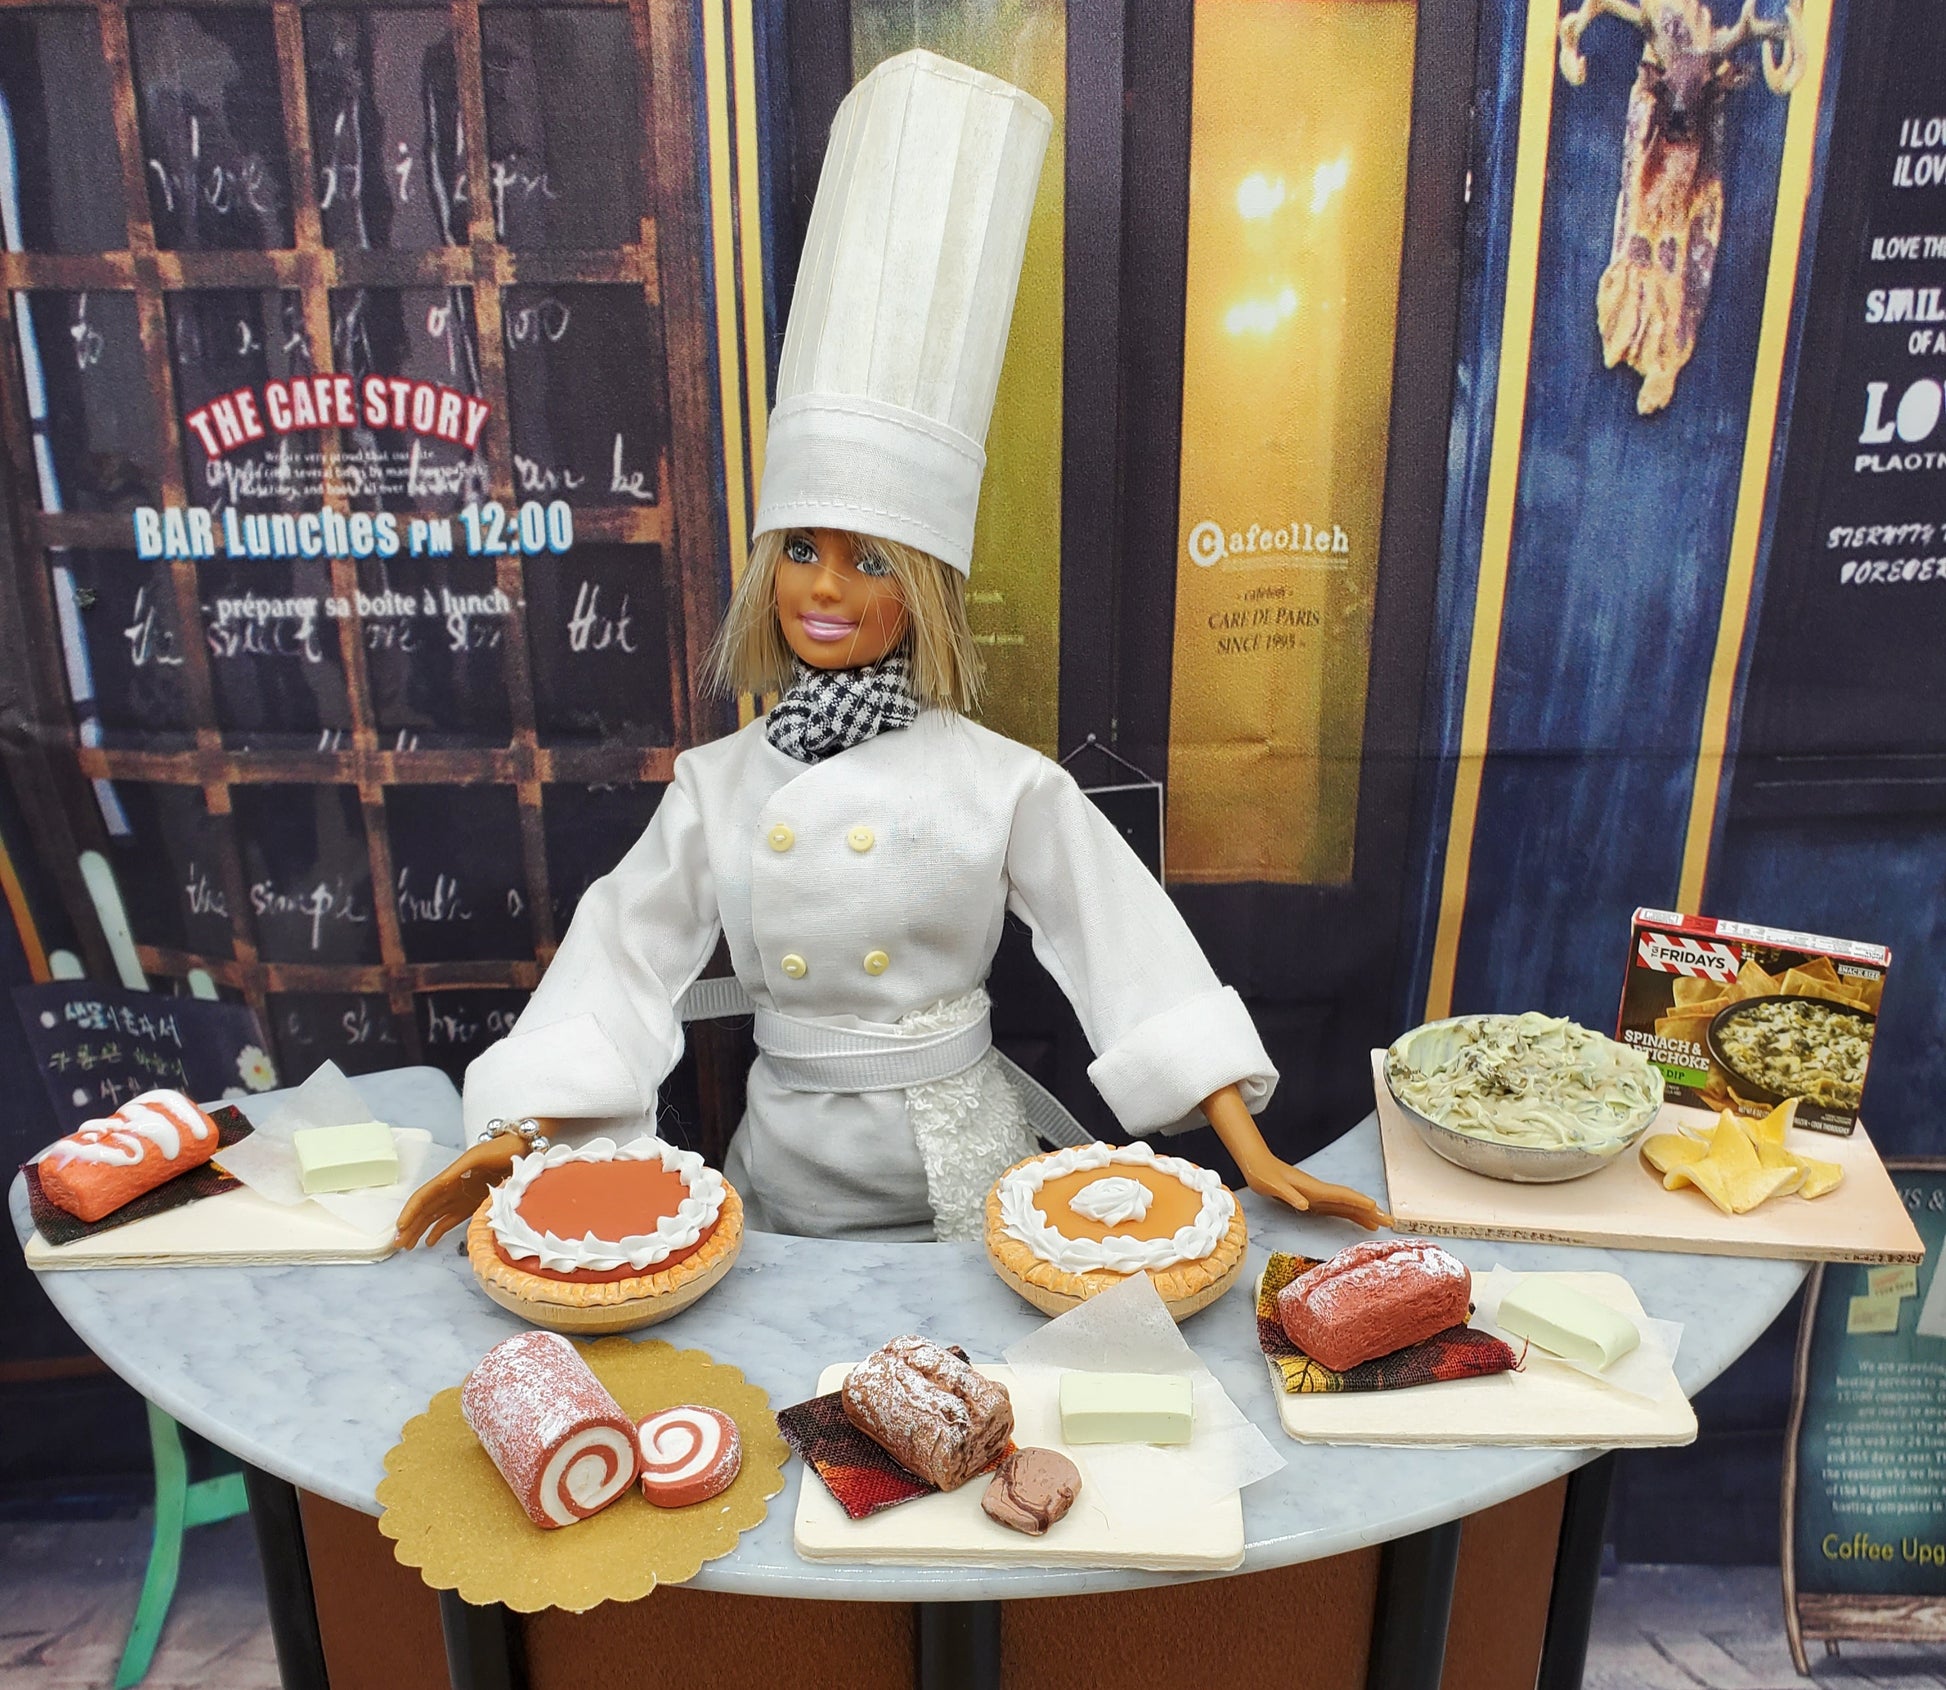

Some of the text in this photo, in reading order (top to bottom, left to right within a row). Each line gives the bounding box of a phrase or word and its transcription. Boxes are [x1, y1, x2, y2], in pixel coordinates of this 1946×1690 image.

[1892, 154, 1946, 187] ILOV
[1865, 288, 1946, 323] SMIL
[1908, 330, 1933, 355] OF
[188, 376, 489, 458] THE CAFE STORY
[1858, 379, 1946, 444] LO
[133, 499, 574, 560] BAR Lunches PM 12:00
[216, 586, 511, 626] préparer sa boîte à lunch
[1275, 607, 1321, 629] PARIS
[1216, 634, 1262, 656] SINCE
[1660, 947, 1726, 970] FRIDAYS
[1624, 1030, 1702, 1056] SPINACH &
[1633, 1044, 1710, 1071] TICHOKE
[1666, 1069, 1685, 1080] DIP
[1927, 1188, 1945, 1214] &
[1822, 1532, 1895, 1560] Coffee
